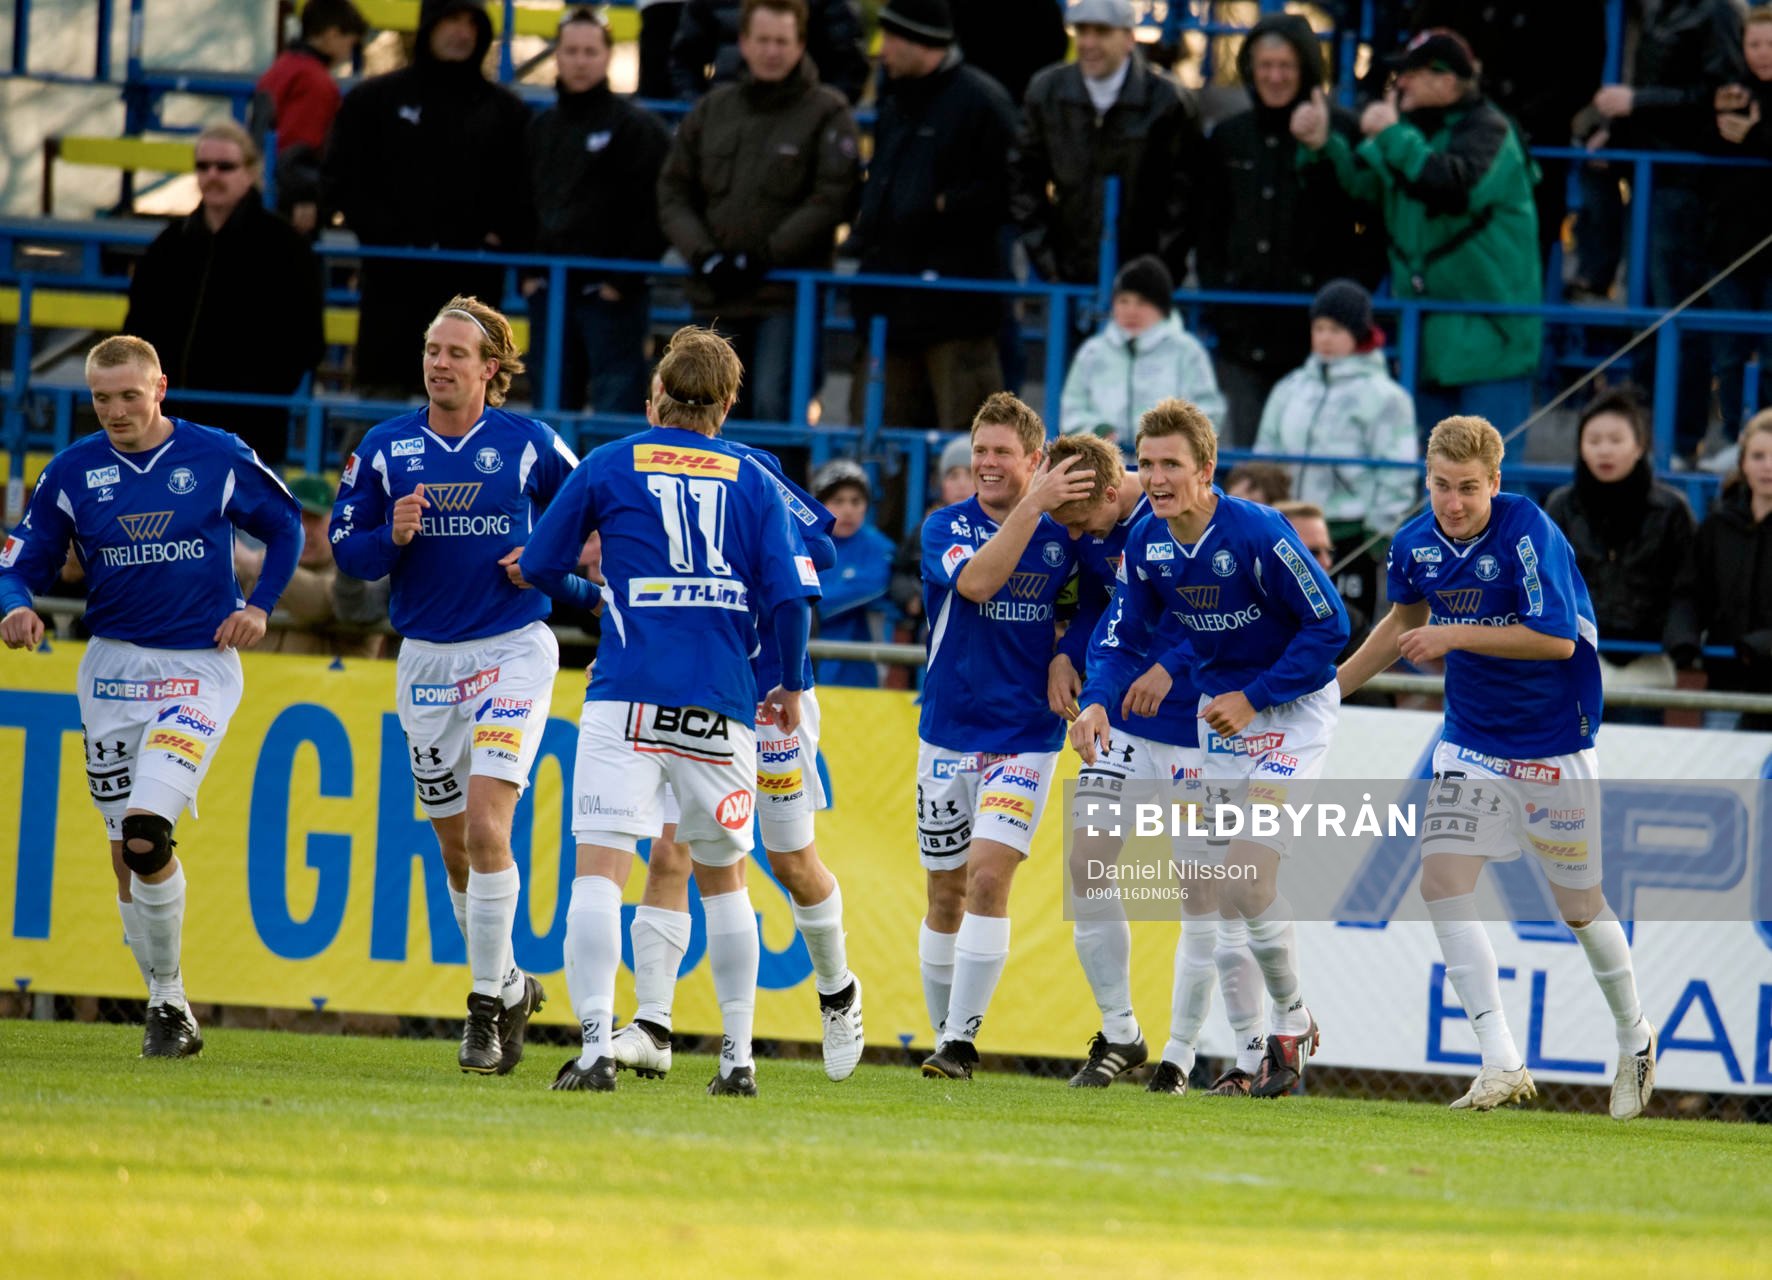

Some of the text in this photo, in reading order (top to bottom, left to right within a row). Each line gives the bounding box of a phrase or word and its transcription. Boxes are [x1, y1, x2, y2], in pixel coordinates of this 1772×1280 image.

[651, 451, 723, 471] DHL
[417, 514, 510, 537] ELLEBORG
[648, 475, 732, 577] 11
[99, 538, 206, 567] TRELLEBORG
[671, 584, 749, 606] TT-Line
[979, 601, 1054, 622] TRELLEBO
[154, 681, 196, 699] HEAT
[492, 697, 533, 708] INTER
[180, 704, 217, 729] INTER
[491, 708, 531, 719] SPORT
[652, 704, 730, 741] BCA
[175, 714, 216, 737] SPORT
[154, 733, 195, 755] DHL
[477, 731, 515, 745] DHL
[761, 735, 800, 753] INTER
[761, 747, 800, 764] SPORT
[935, 755, 979, 778] POER
[1004, 764, 1041, 783] INTER
[1514, 765, 1557, 783] HEAT
[1002, 774, 1039, 793] SPORT
[720, 795, 751, 824] AXA
[984, 796, 1026, 814] DHL
[1549, 808, 1586, 820] INTER
[1549, 819, 1586, 831] SPORT
[1534, 840, 1579, 858] DHL
